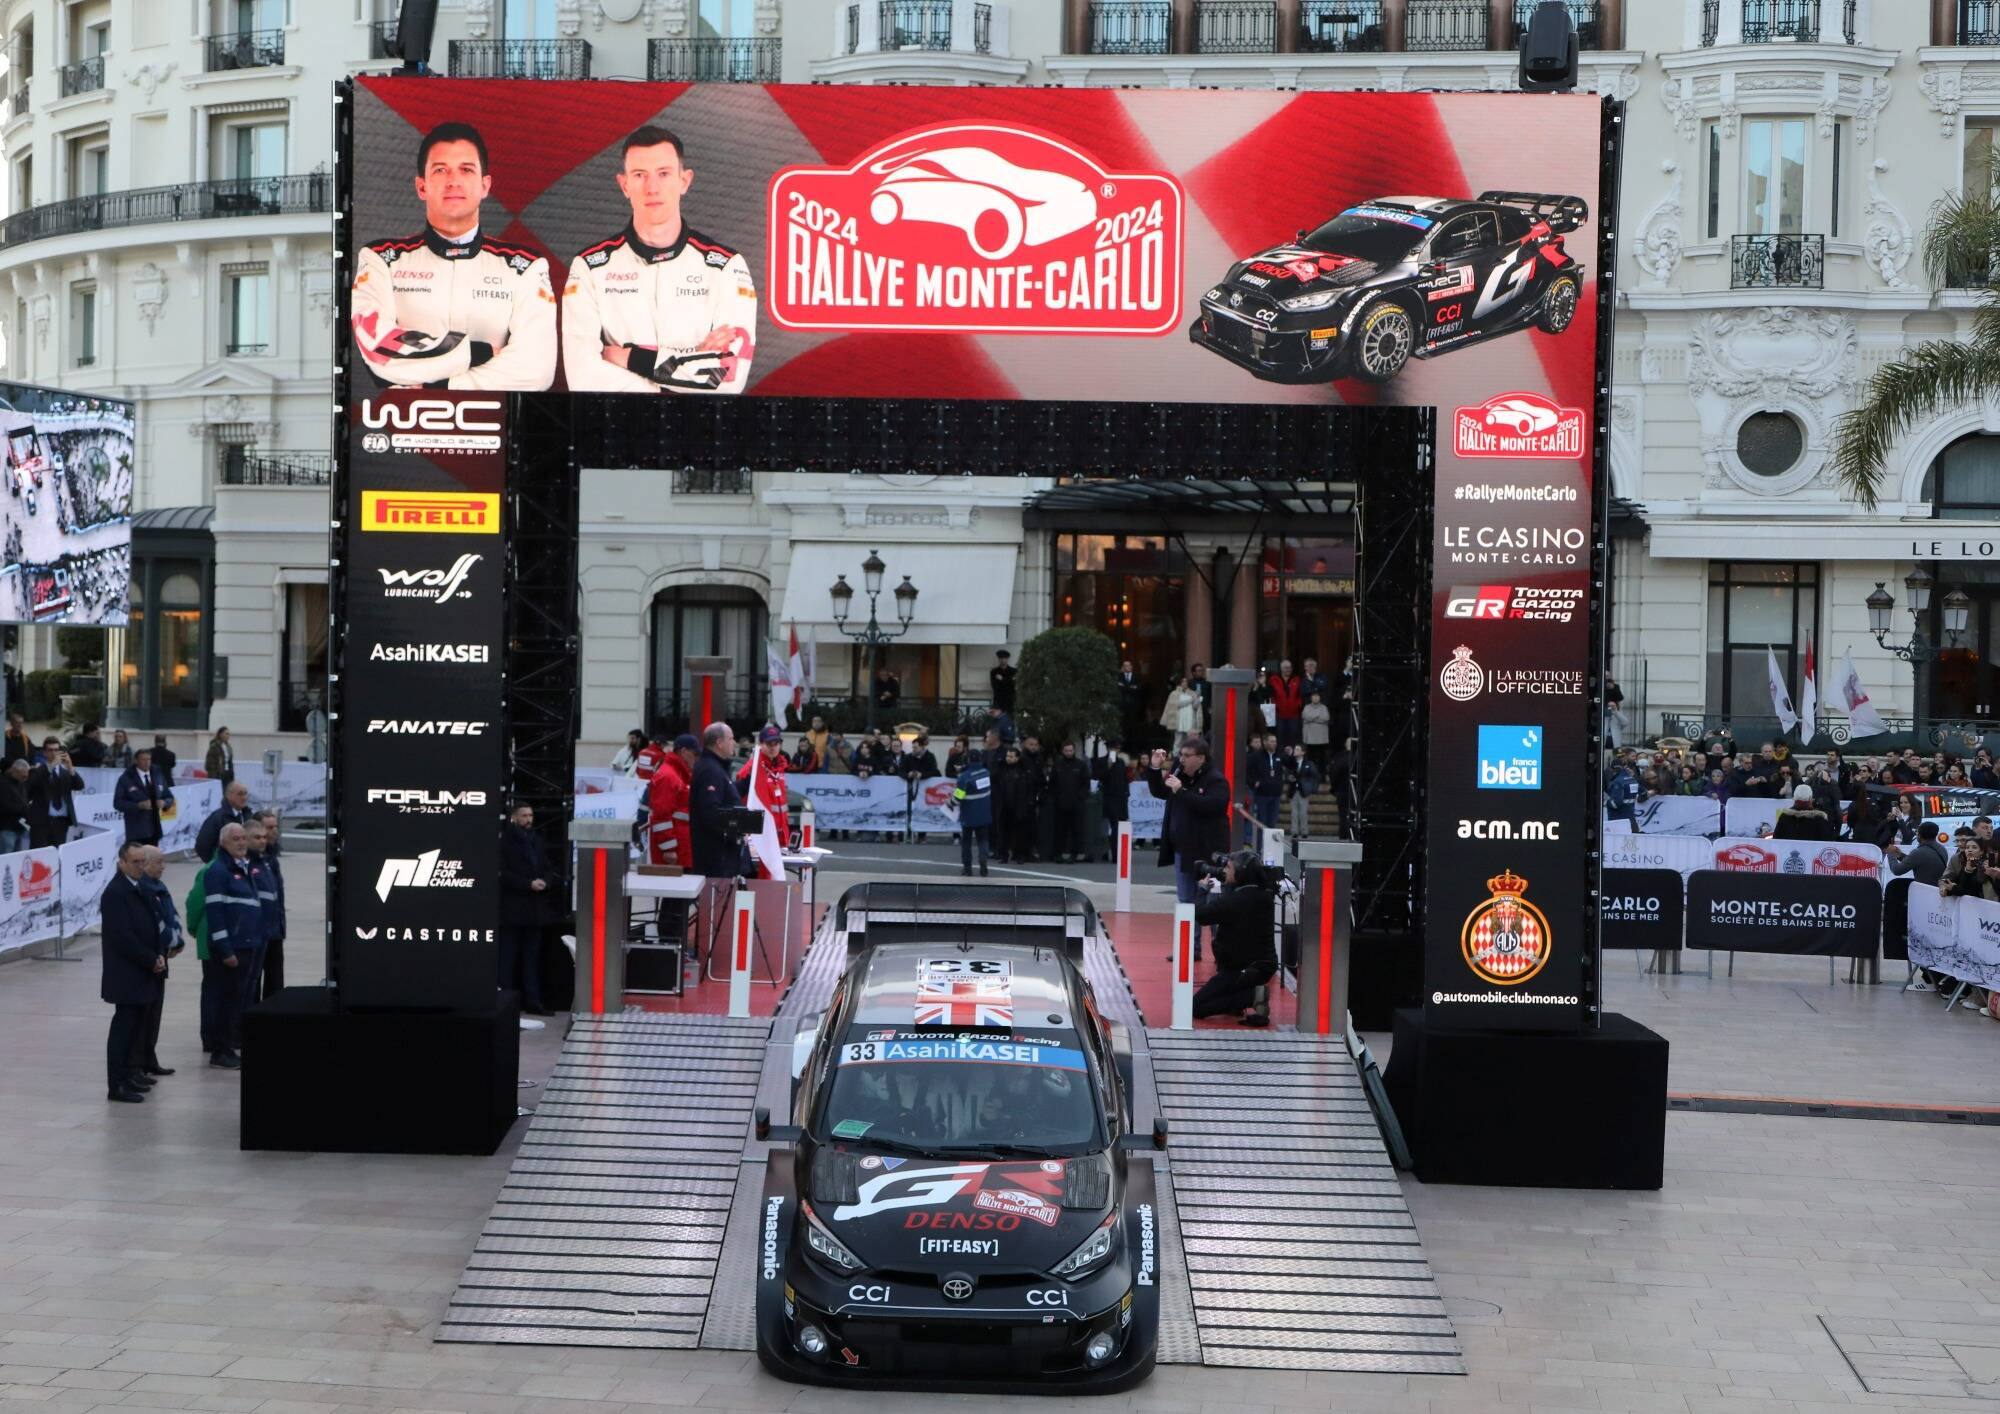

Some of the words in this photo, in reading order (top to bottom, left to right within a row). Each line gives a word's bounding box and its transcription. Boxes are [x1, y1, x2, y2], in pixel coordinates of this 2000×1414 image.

[788, 191, 859, 246] 2024
[1094, 200, 1163, 250] 2024
[787, 222, 904, 308] RALLYE
[917, 230, 1163, 310] MONTE-CARLO
[1249, 262, 1293, 279] DENSO
[393, 270, 434, 280] DENSO
[362, 398, 501, 431] WRC
[1460, 414, 1483, 431] 2024
[1557, 416, 1579, 433] 2024
[364, 436, 387, 449] FIA
[1459, 426, 1497, 451] RALLYE
[1455, 484, 1577, 503] #RallyeMonteCarlo
[376, 499, 487, 525] PIRELLI
[1444, 527, 1470, 547] LE
[1477, 527, 1585, 549] CASINO
[1912, 542, 1942, 556] LE
[385, 588, 440, 598] LUBRICANTS
[1340, 580, 1355, 593] PA
[1515, 587, 1584, 598] TOYOTA
[1447, 599, 1505, 617] GR
[1511, 599, 1575, 609] GAZOO
[1509, 609, 1572, 622] Racing
[370, 643, 489, 663] AsahiKASEI
[1497, 670, 1512, 681] LA
[1515, 670, 1583, 684] BOUTIQUE
[1496, 682, 1582, 695] OFFICIELLE
[367, 719, 486, 735] FANATEC
[1512, 758, 1537, 766] france
[1481, 760, 1538, 785] bleu
[367, 789, 487, 806] FORUM8
[1131, 800, 1163, 808] CASIN
[399, 805, 455, 814] フォーラムエイト
[93, 812, 124, 823] FANATE
[1457, 820, 1560, 840] acm.mc
[436, 860, 463, 870] FUEL
[1611, 853, 1664, 865] CASINO
[433, 869, 457, 878] FOR
[429, 878, 475, 888] CHANGE
[1639, 913, 1659, 921] MER
[1711, 915, 1754, 925] SOCIÉTÉ
[1758, 918, 1778, 926] DES
[1782, 918, 1813, 927] BAINS
[1817, 920, 1830, 928] DE
[1834, 921, 1856, 929] MER
[386, 927, 494, 942] CASTORE
[1432, 991, 1578, 1005] @automobileclubmonaco
[899, 1032, 954, 1040] TOYOTA
[958, 1032, 1010, 1041] GAZOO
[1013, 1035, 1061, 1047] Racing
[850, 1043, 876, 1061] 33
[887, 1042, 1040, 1063] AsahiKASEI
[977, 1196, 1003, 1209] RALLYE
[904, 1212, 1021, 1232] DENSO
[764, 1196, 785, 1280] Panasonic
[1137, 1203, 1154, 1286] Panasonic
